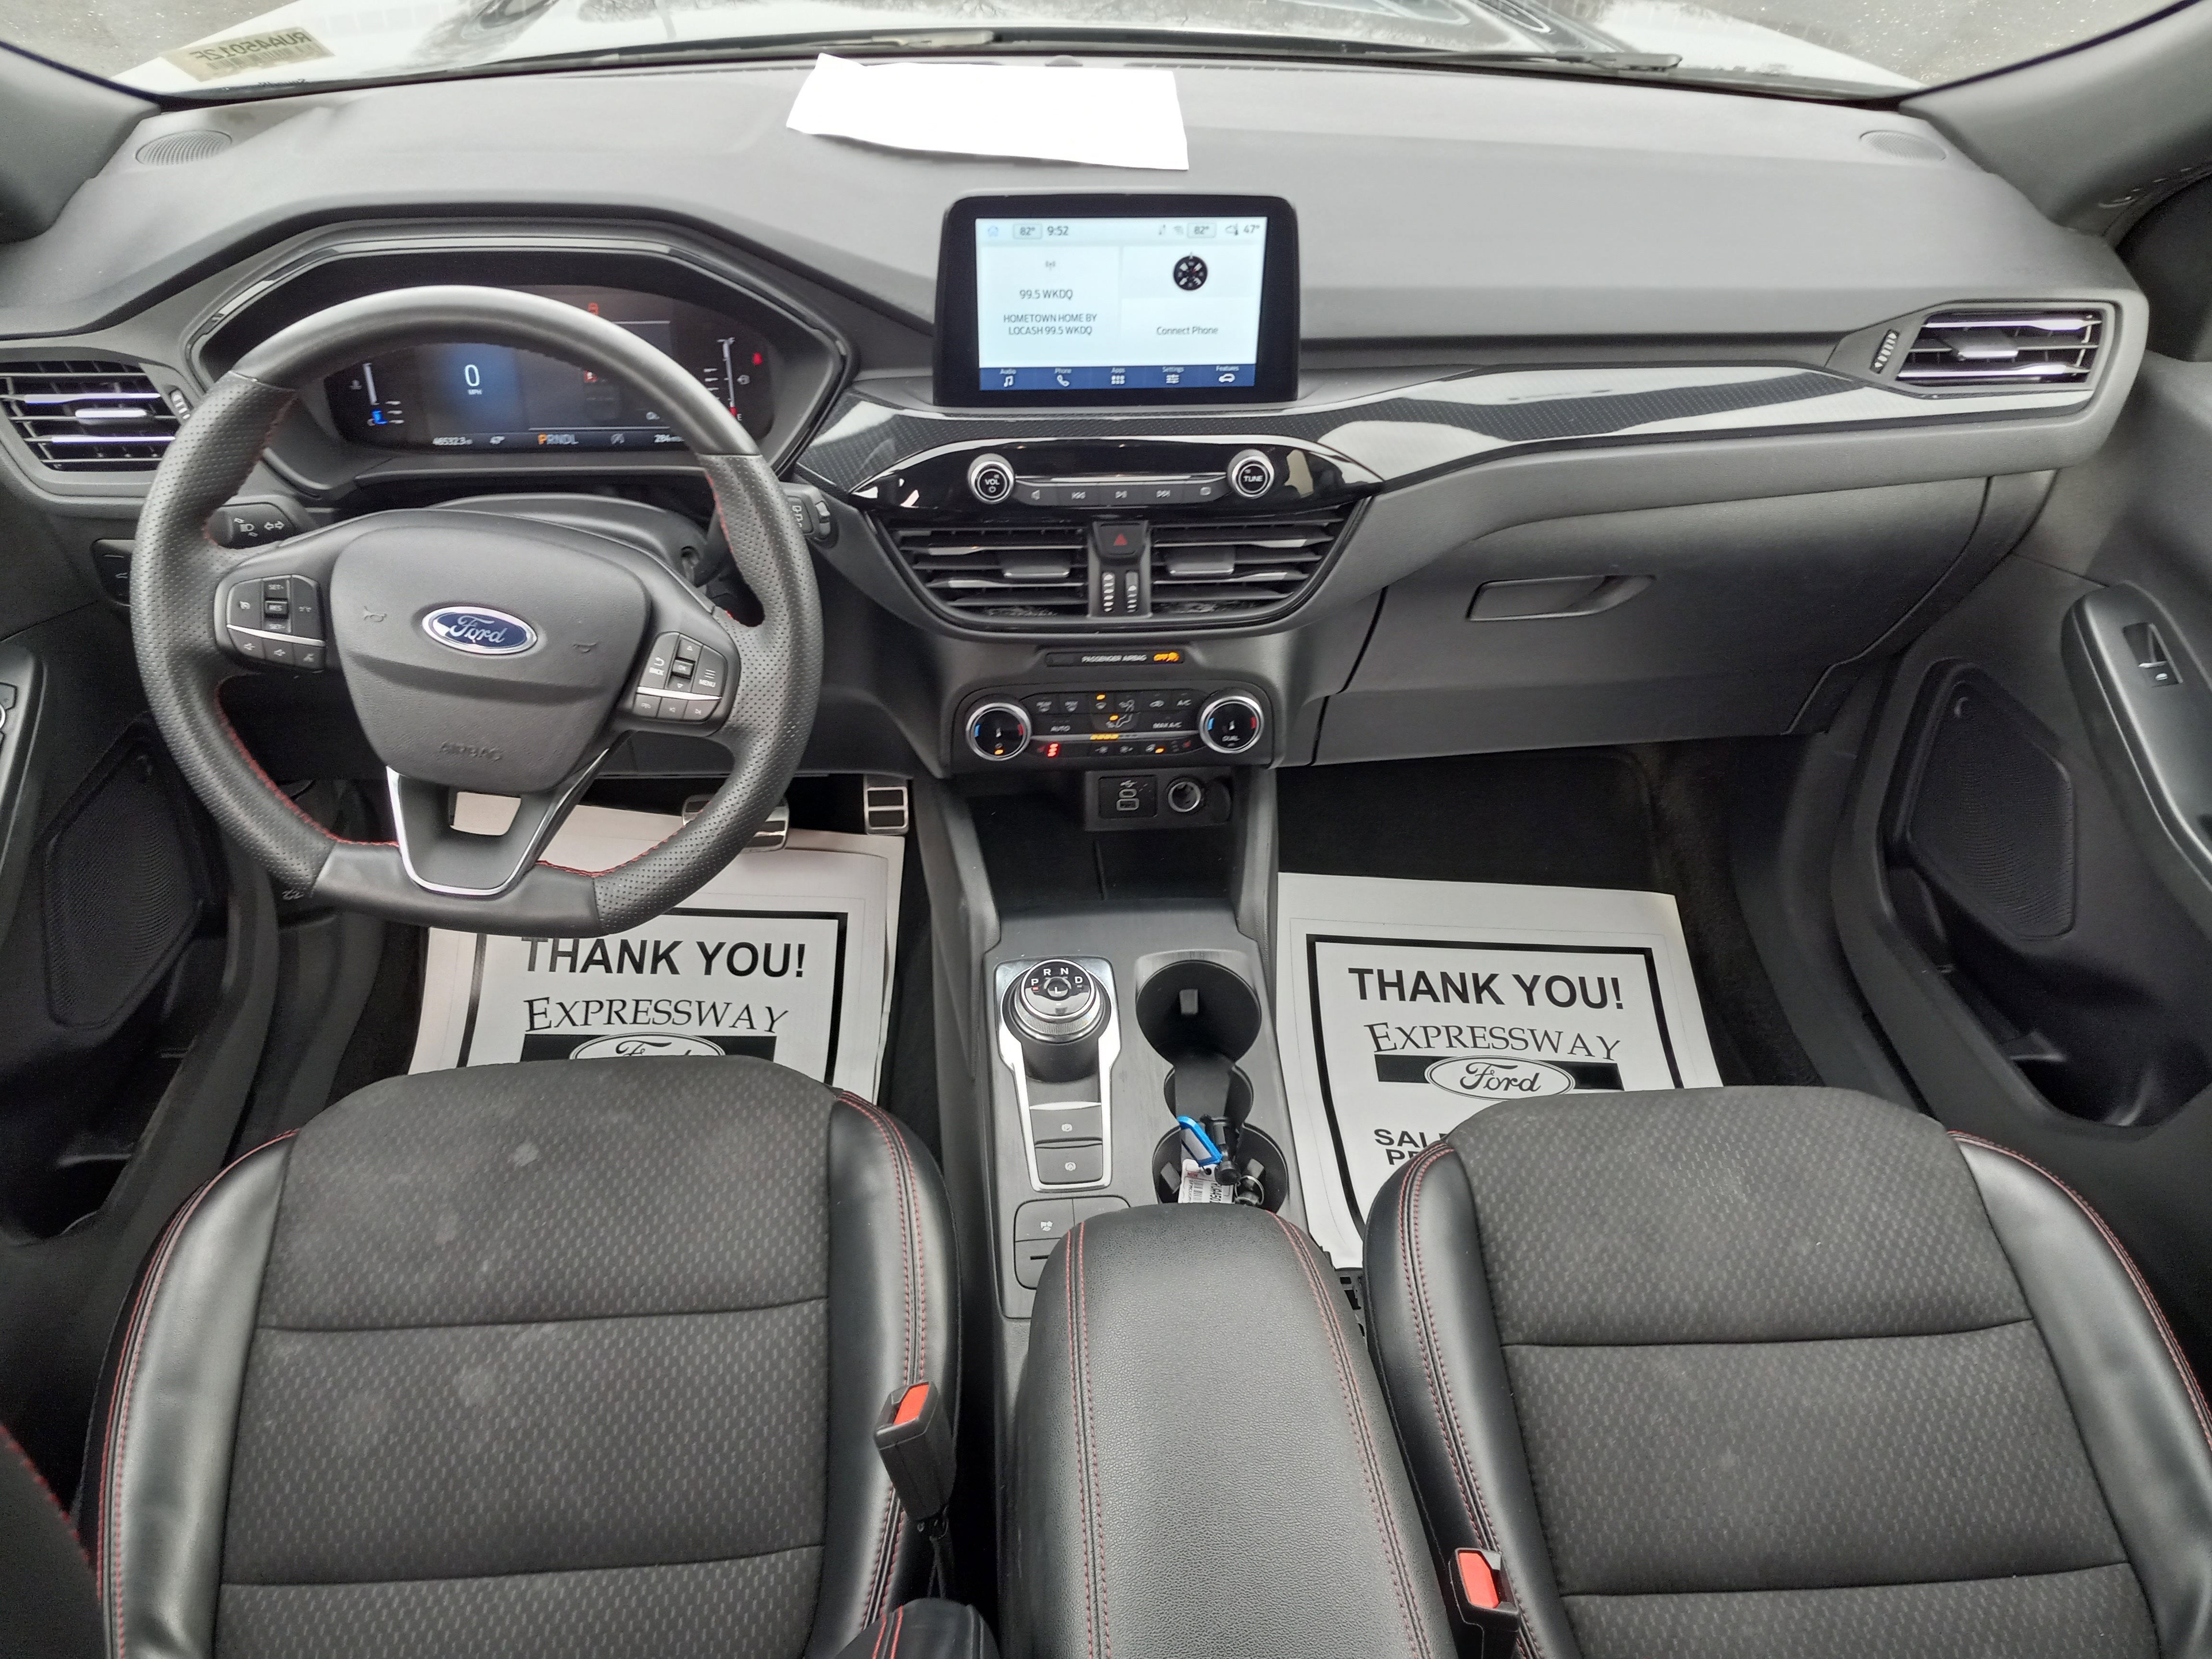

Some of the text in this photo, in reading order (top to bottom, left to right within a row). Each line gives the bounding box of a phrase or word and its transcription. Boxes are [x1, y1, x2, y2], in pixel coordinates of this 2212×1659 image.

[1047, 226, 1069, 237] 9:52
[1019, 289, 1073, 300] 99.5 WKDQ
[1003, 313, 1097, 323] HOMETOWN HOME BY
[1009, 326, 1093, 336] LOCASH 99.5 WKDQ
[1156, 325, 1218, 335] Connect Phone
[449, 615, 508, 643] Ford
[698, 679, 716, 688] MENU
[521, 937, 805, 977] THANK YOU!
[1031, 978, 1039, 986] P
[1348, 967, 1624, 1010] THANK YOU!
[523, 997, 789, 1034] EXPRESSWAY
[1364, 1022, 1621, 1061] EXPRESSWAY
[1459, 1062, 1541, 1093] Ford
